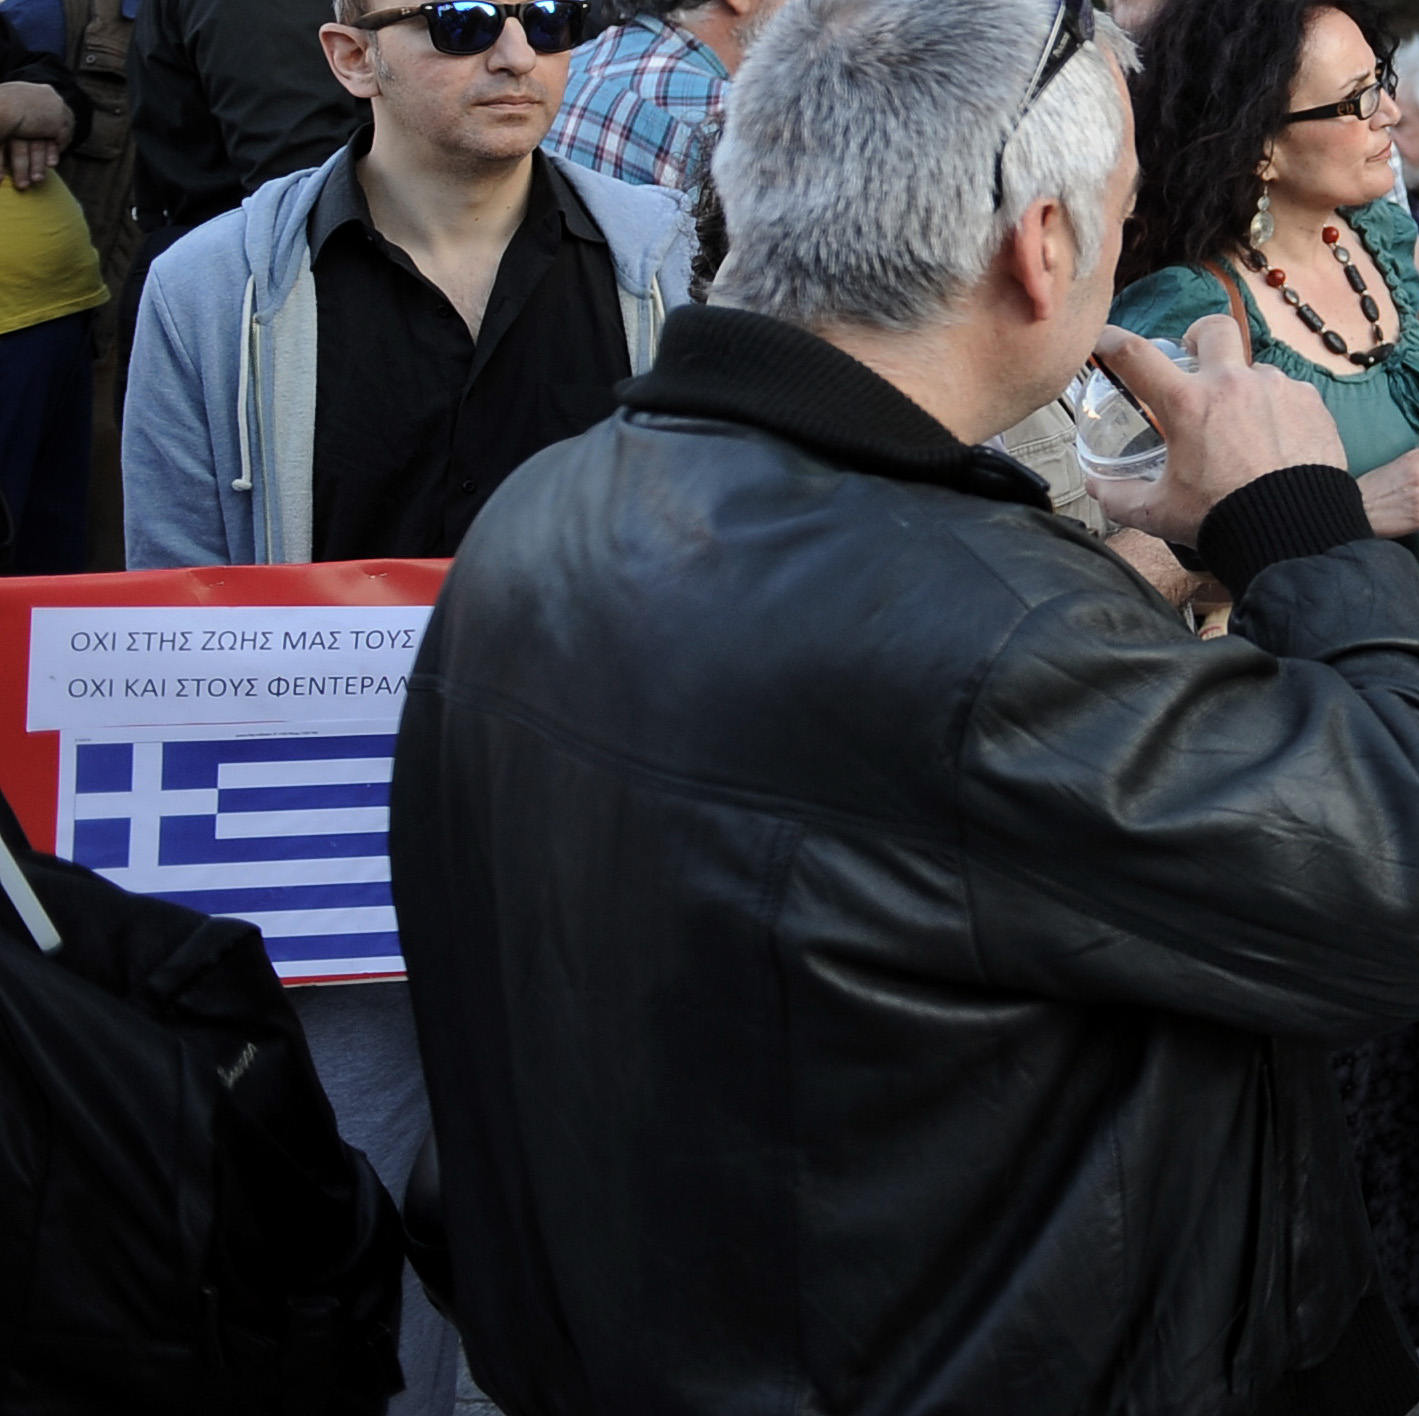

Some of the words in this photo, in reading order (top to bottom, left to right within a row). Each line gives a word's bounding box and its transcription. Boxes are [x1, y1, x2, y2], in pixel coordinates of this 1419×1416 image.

[70, 631, 117, 652] ΟΧΙ
[126, 631, 193, 652] ΣΤΗΣ
[201, 630, 274, 651] ΖΩΗΣ
[282, 630, 342, 651] ΜΑΣ
[350, 628, 416, 650] ΤΟΥΣ
[67, 678, 114, 698] ΟΧΙ
[124, 678, 166, 698] ΚΑΙ
[175, 677, 259, 698] ΣΤΟΥΣ
